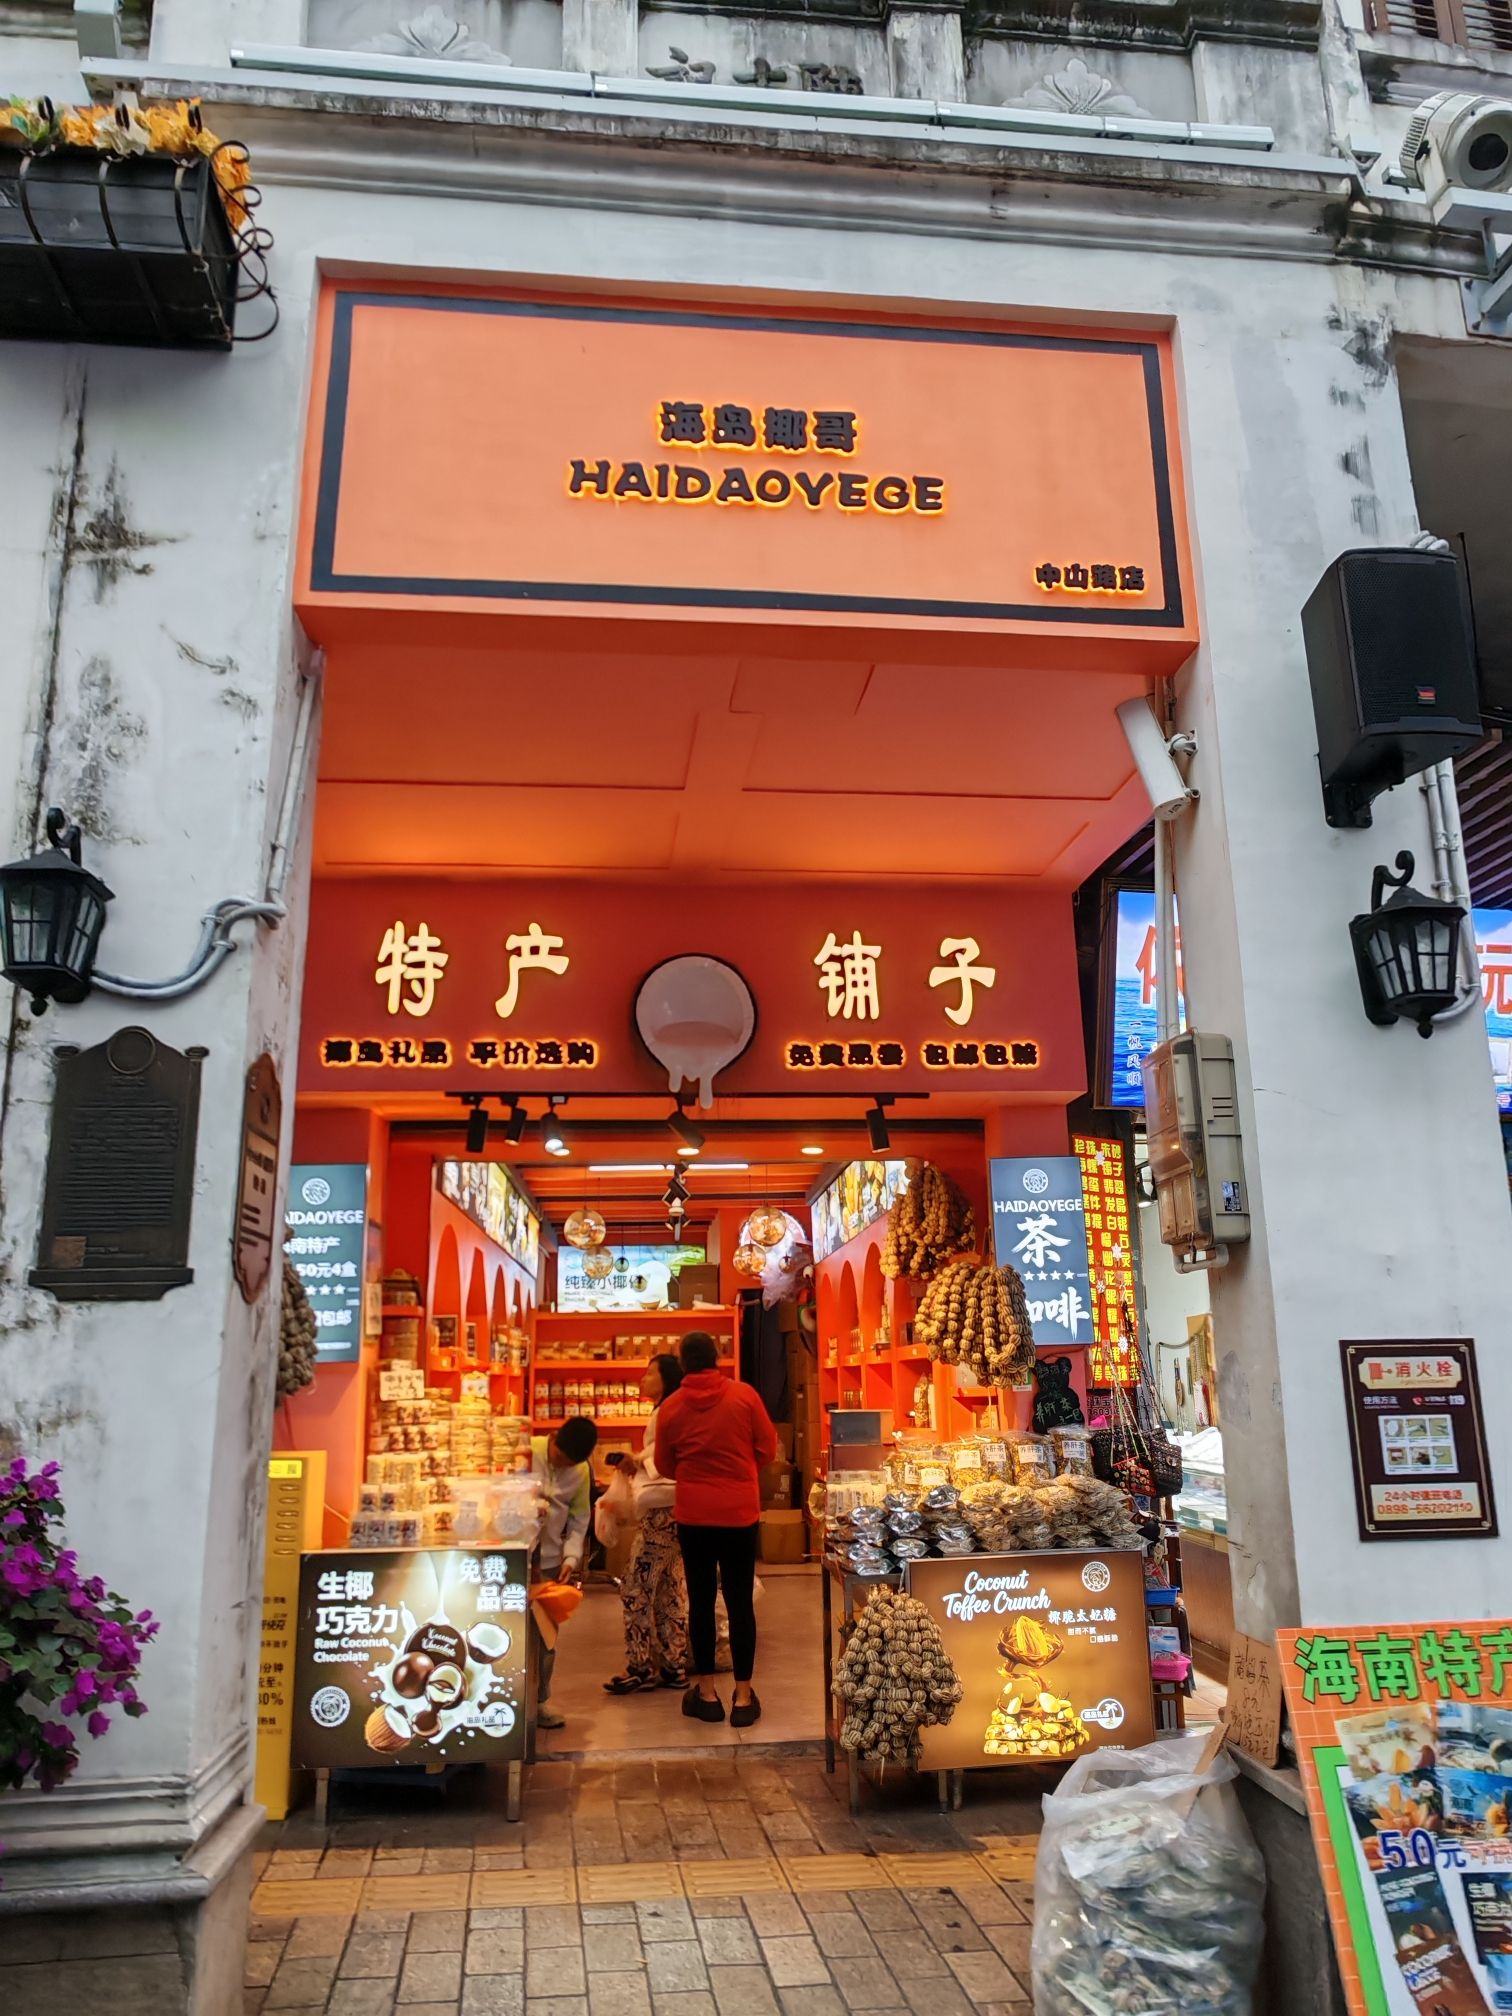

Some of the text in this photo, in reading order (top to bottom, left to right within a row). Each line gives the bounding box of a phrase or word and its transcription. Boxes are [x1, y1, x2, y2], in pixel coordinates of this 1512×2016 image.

[660, 401, 858, 452] 海岛椰哥
[569, 459, 944, 511] HAIDAOYEGE
[1035, 562, 1145, 591] 中山路店
[375, 920, 996, 1026] 特产 铺子
[1075, 1138, 1096, 1155] 珍珠
[994, 1198, 1082, 1213] HAIDAOYEGE
[1011, 1213, 1071, 1268] 茶
[1395, 1360, 1453, 1377] 消火栓
[459, 1554, 507, 1584] 免费
[964, 1570, 1029, 1594] Coconut
[317, 1571, 375, 1601] 生椰
[476, 1583, 527, 1613] 品尝
[942, 1588, 1052, 1621] Toffee Crunch
[315, 1604, 399, 1636] 巧克力
[313, 1650, 370, 1663] Chocolate
[314, 1636, 390, 1650] Raw Coconut
